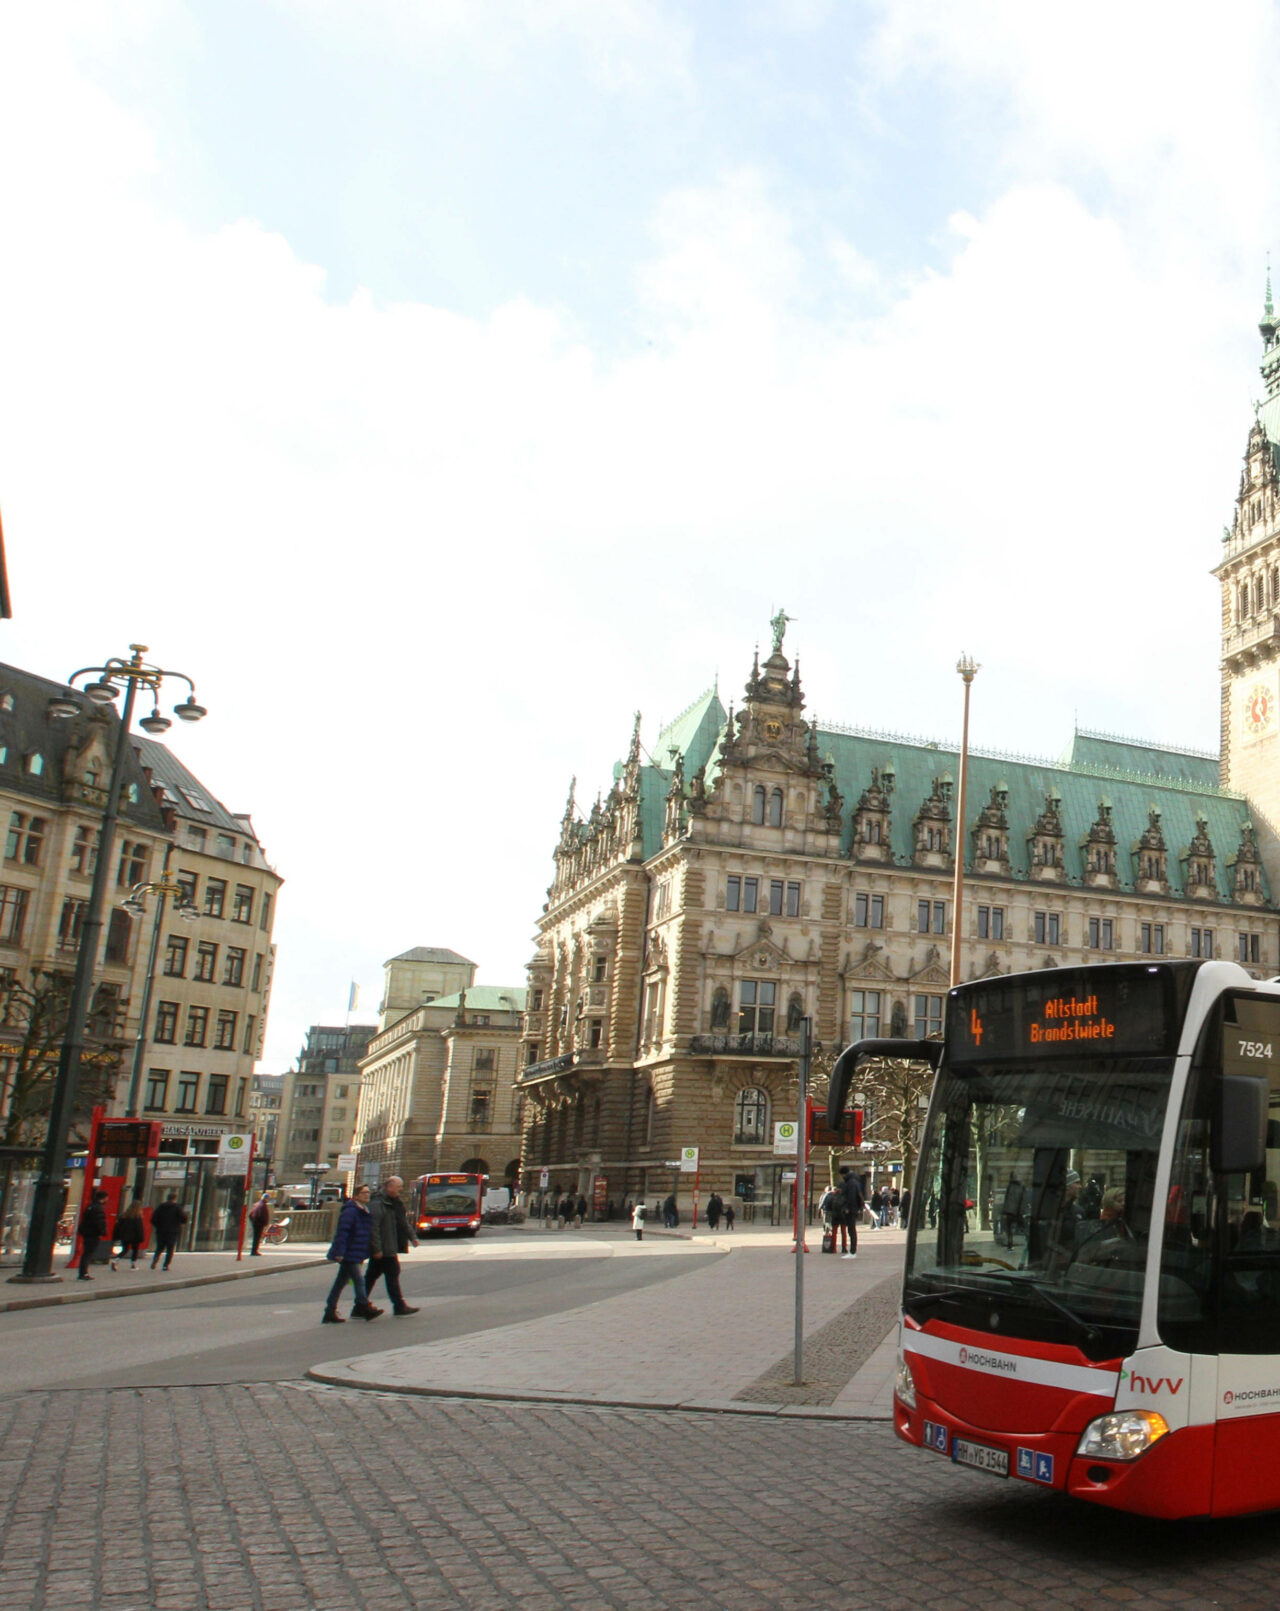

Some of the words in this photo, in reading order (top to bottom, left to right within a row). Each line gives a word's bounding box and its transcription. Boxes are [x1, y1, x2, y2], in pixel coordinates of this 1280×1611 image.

[1045, 995, 1098, 1019] Altstadt
[971, 1008, 984, 1046] 4
[1030, 1017, 1115, 1043] Brandstwiete
[1238, 1040, 1273, 1059] 7524
[968, 1352, 1017, 1372] HOCHBAHN
[1129, 1370, 1184, 1395] hvv
[958, 1442, 968, 1461] HH
